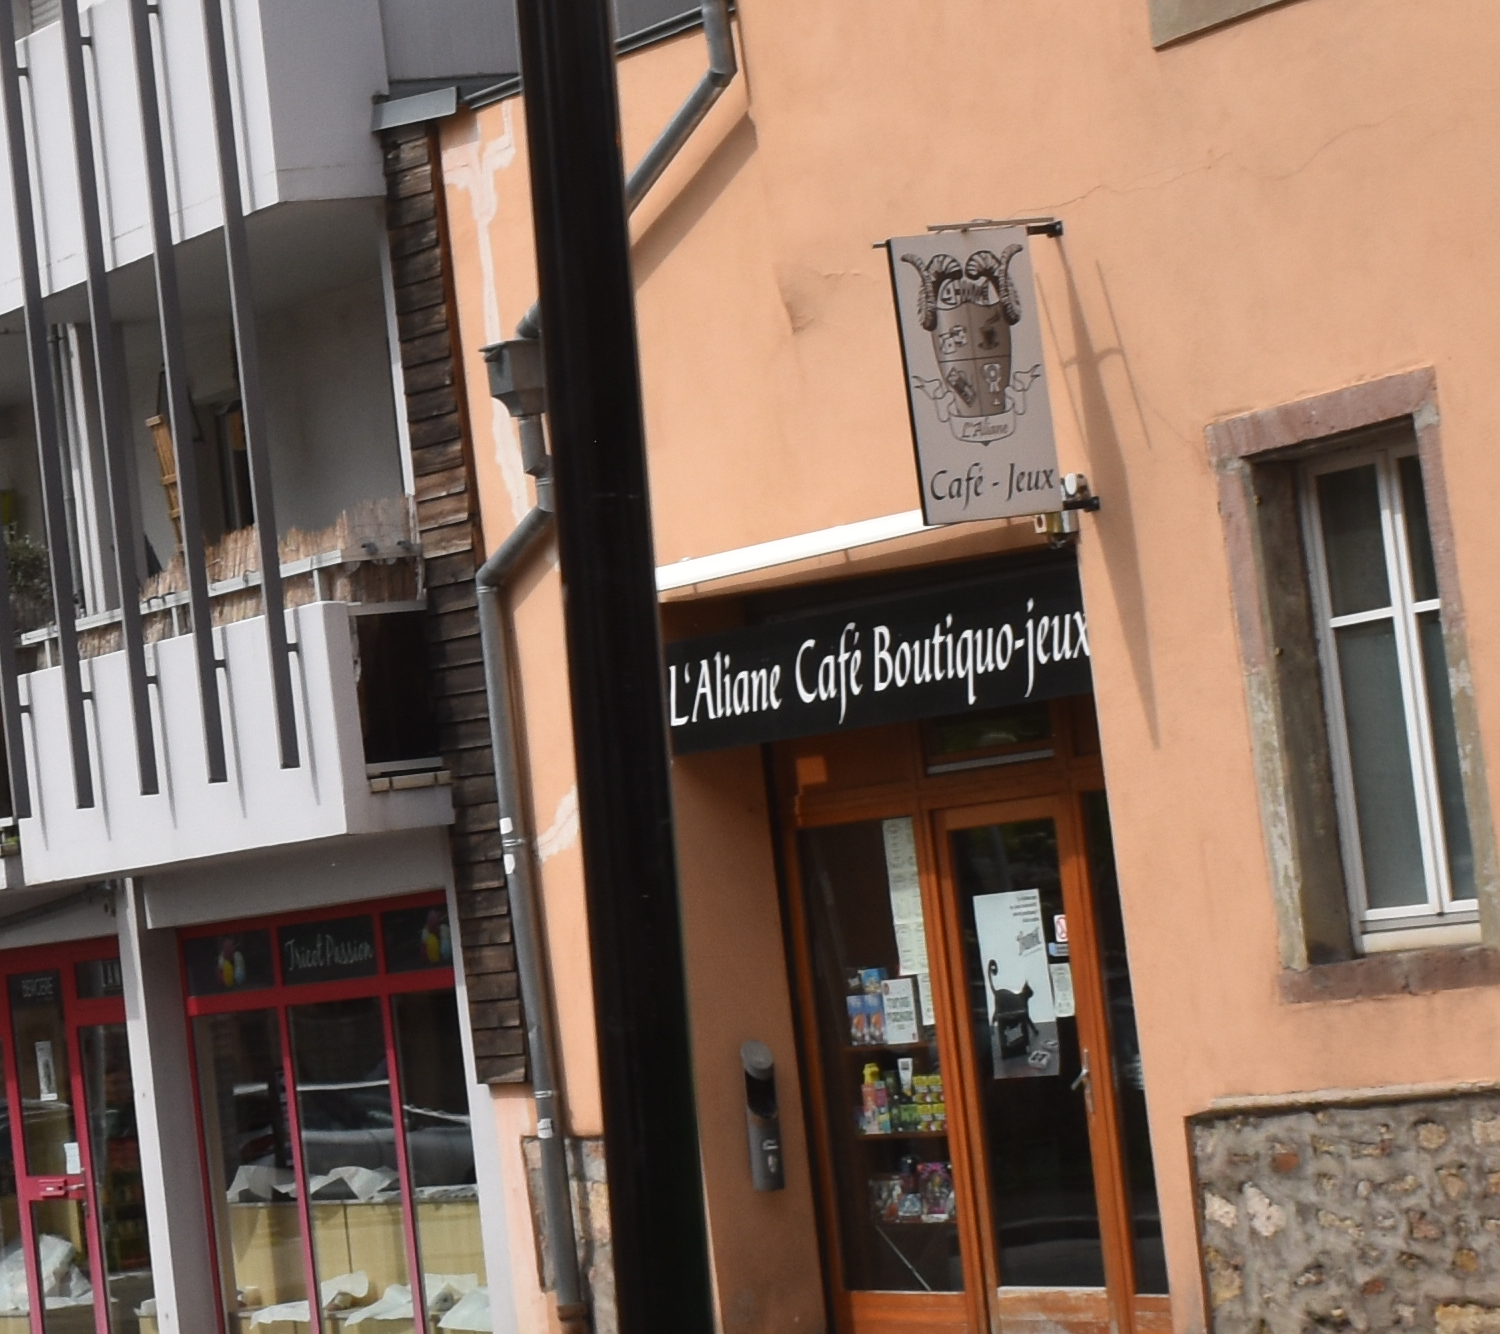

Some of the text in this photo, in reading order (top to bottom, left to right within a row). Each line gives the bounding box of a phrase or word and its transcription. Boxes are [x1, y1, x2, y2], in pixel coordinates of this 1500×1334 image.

[930, 463, 984, 511] Café
[1005, 463, 1054, 502] Jeux
[669, 597, 1090, 727] L'Aliane Café Boutiquo-jeux
[284, 933, 374, 971] Tricot Passion
